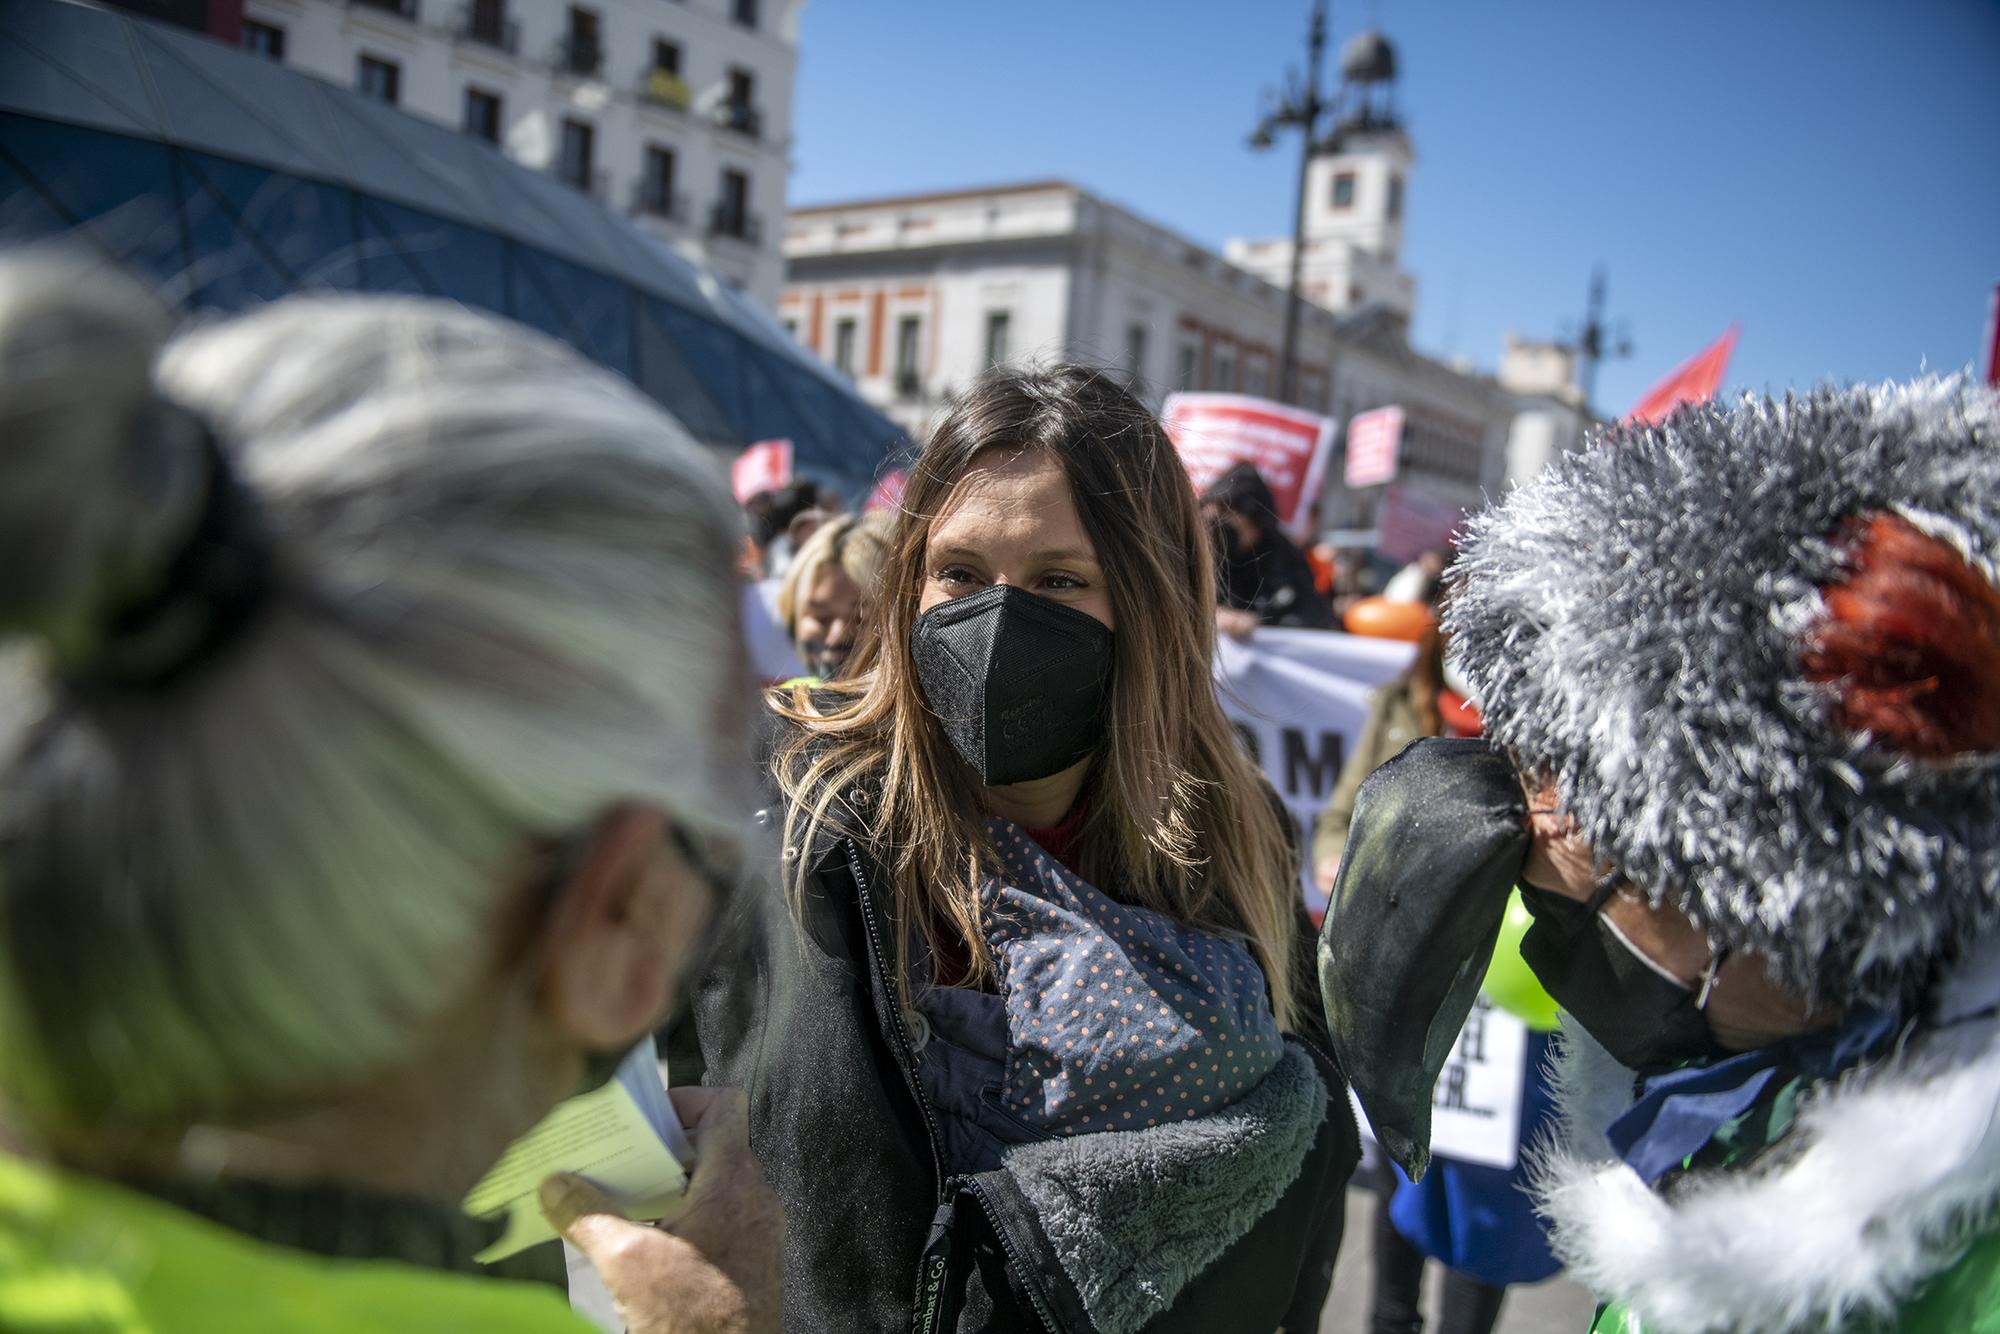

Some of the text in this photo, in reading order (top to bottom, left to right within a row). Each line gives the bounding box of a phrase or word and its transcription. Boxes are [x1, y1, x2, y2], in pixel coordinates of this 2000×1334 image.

[914, 1264, 924, 1310] ombat
[923, 1257, 945, 1334] ombat & Co.
